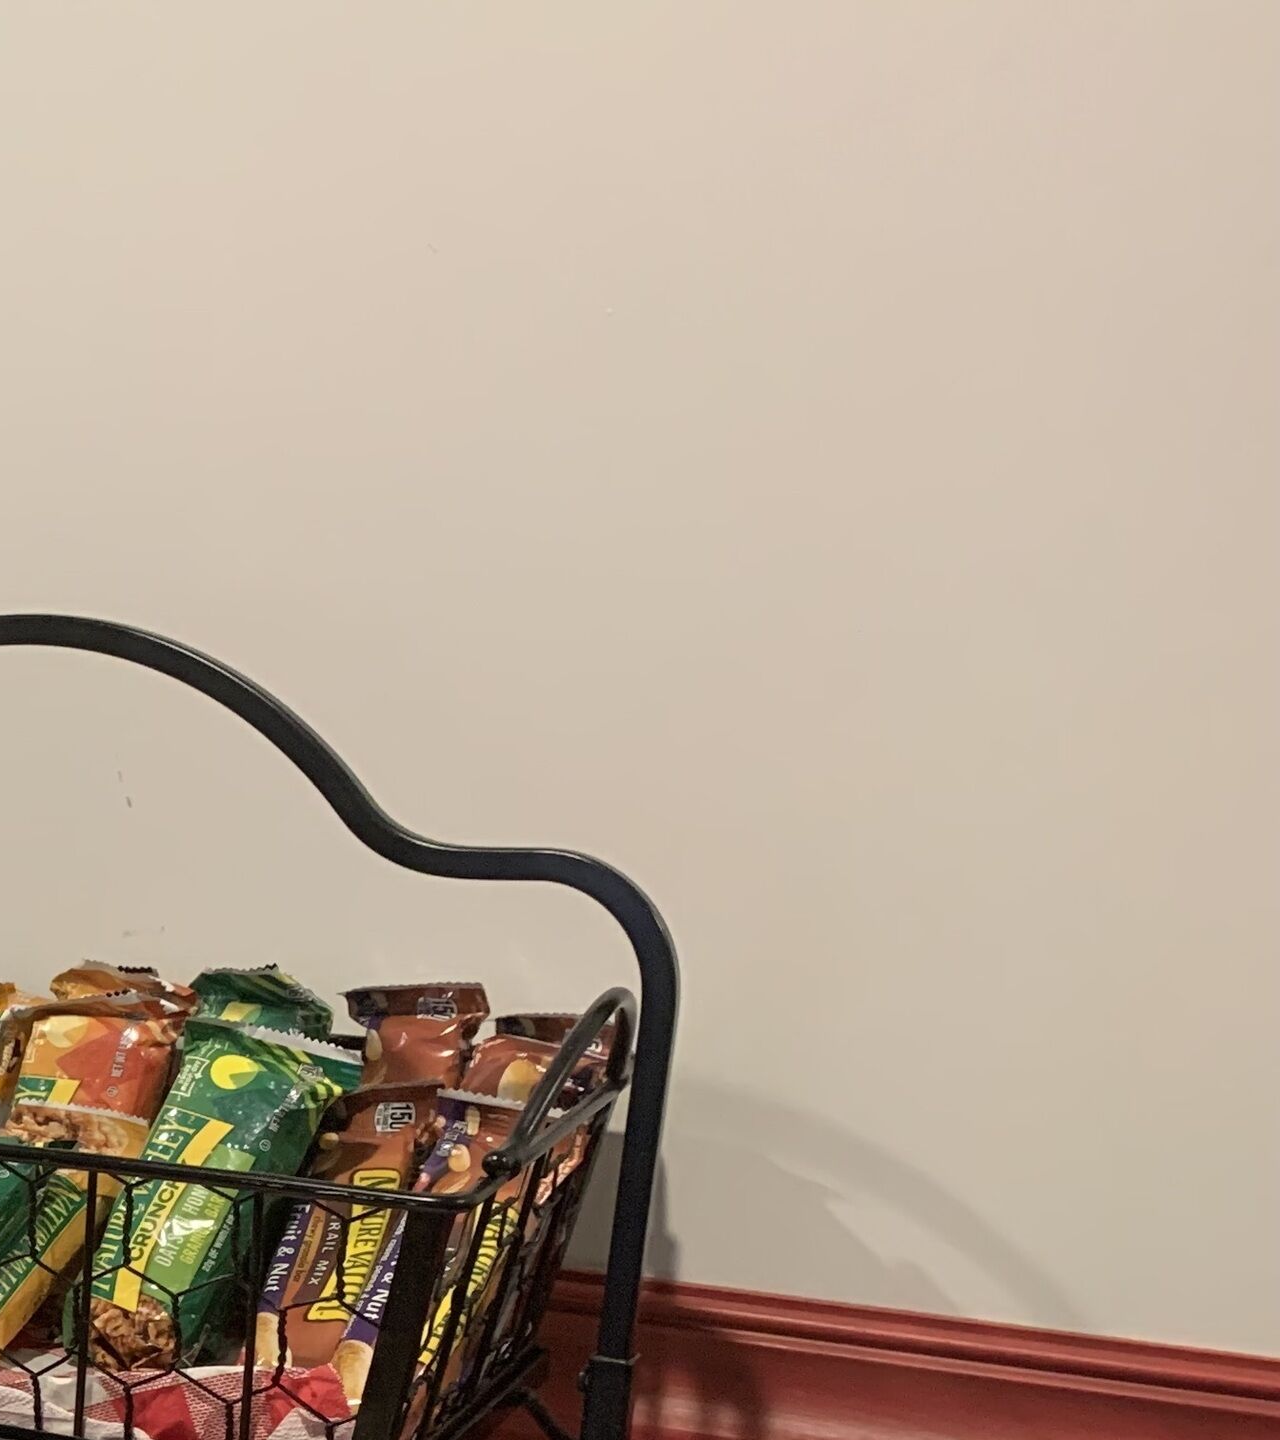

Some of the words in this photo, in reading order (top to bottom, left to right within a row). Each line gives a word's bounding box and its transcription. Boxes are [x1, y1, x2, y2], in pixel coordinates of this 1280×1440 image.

[282, 1203, 311, 1242] Fruit
[264, 1262, 290, 1293] Nut
[308, 1259, 329, 1285] MIX
[364, 1288, 390, 1320] Nut
